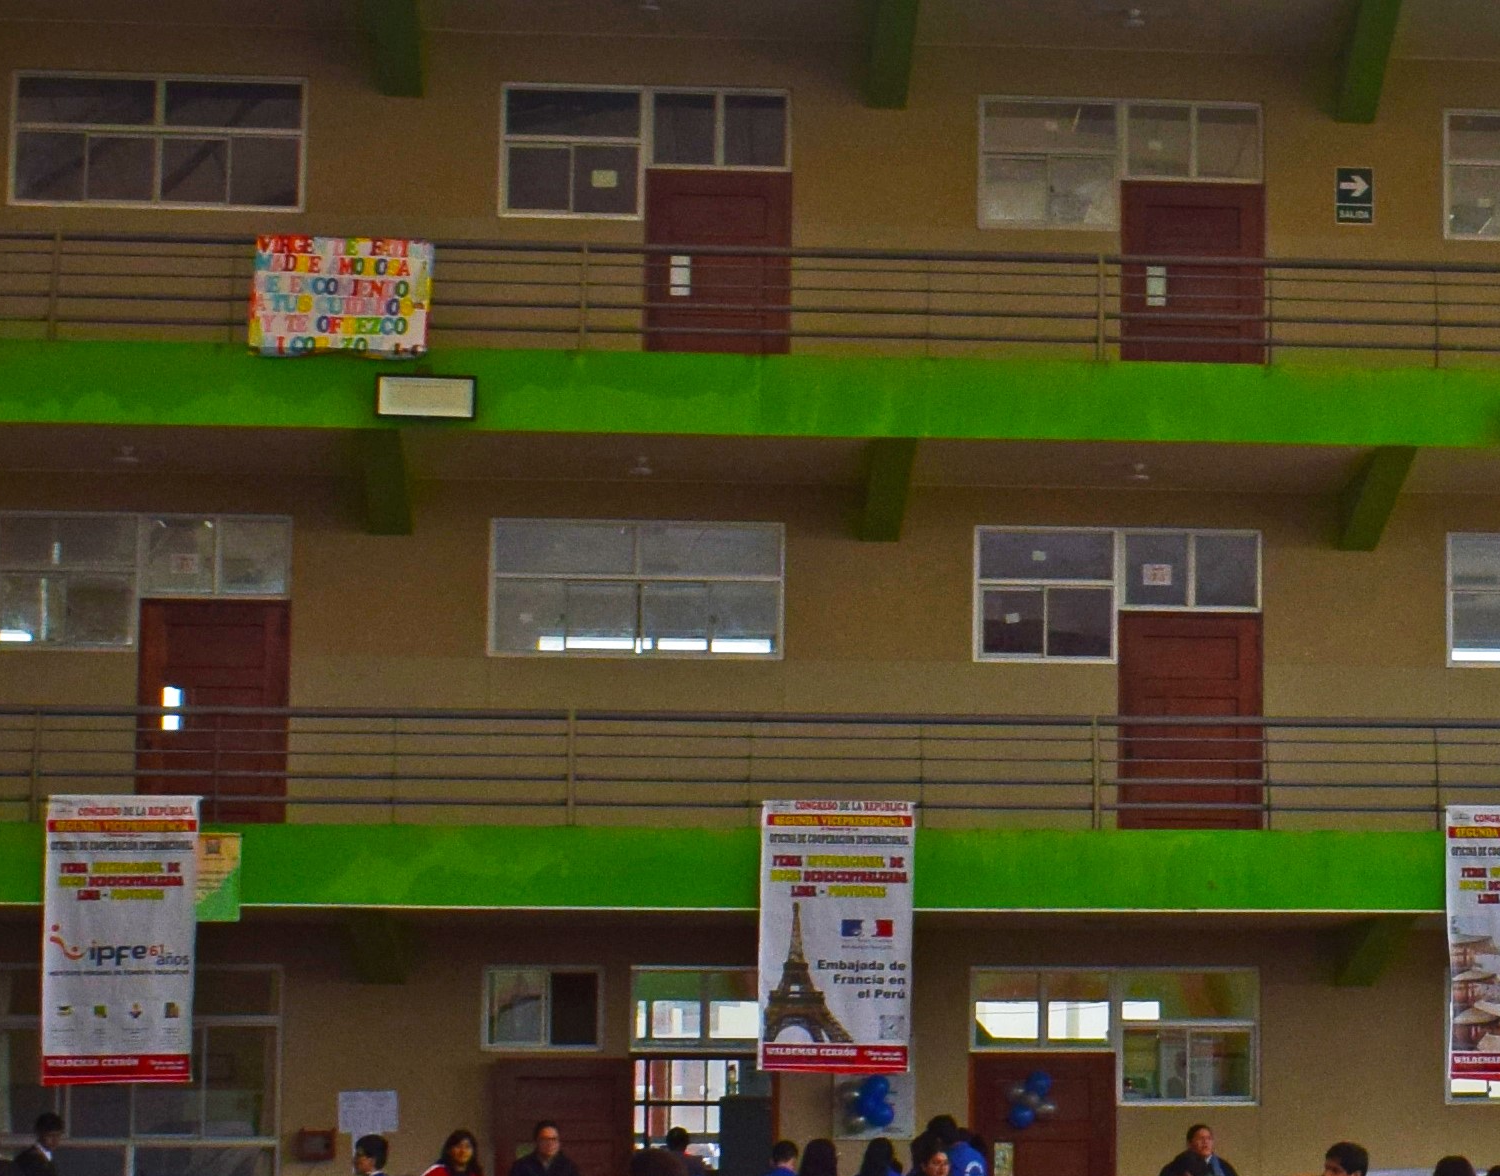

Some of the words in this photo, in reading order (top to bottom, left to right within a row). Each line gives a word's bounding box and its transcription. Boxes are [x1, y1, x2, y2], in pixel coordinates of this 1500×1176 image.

[1338, 209, 1369, 218] SALIDA
[122, 806, 132, 816] DE
[135, 806, 146, 816] LA
[795, 801, 838, 810] CONGRESO
[839, 801, 850, 811] DE
[852, 801, 862, 811] LA
[773, 815, 819, 826] SEGUNDA
[822, 816, 905, 827] VICEPRESIDENCIA
[1455, 827, 1499, 838] SEGUNDA
[89, 939, 148, 966] ipfe
[149, 944, 165, 957] 61
[156, 952, 189, 966] años
[817, 960, 885, 973] Embajada
[889, 960, 906, 971] de
[833, 974, 885, 985] Francia
[888, 976, 906, 985] en
[857, 989, 870, 999] el
[874, 989, 906, 999] Perú
